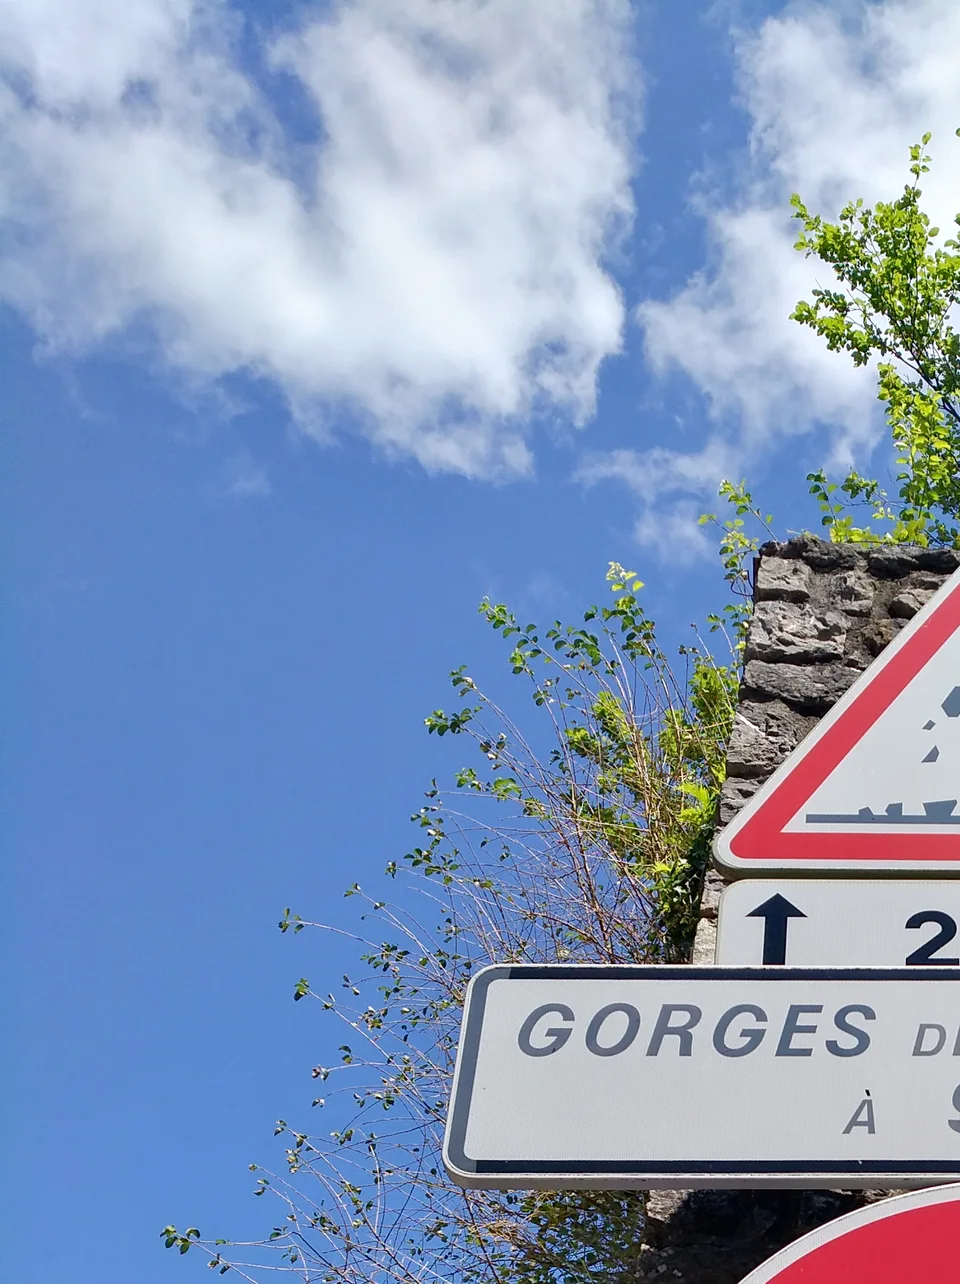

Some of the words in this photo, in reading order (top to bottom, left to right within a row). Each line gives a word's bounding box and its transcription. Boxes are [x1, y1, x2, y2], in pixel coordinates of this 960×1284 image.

[905, 910, 958, 965] 2
[518, 1003, 876, 1057] GORGES
[842, 1089, 876, 1134] À
